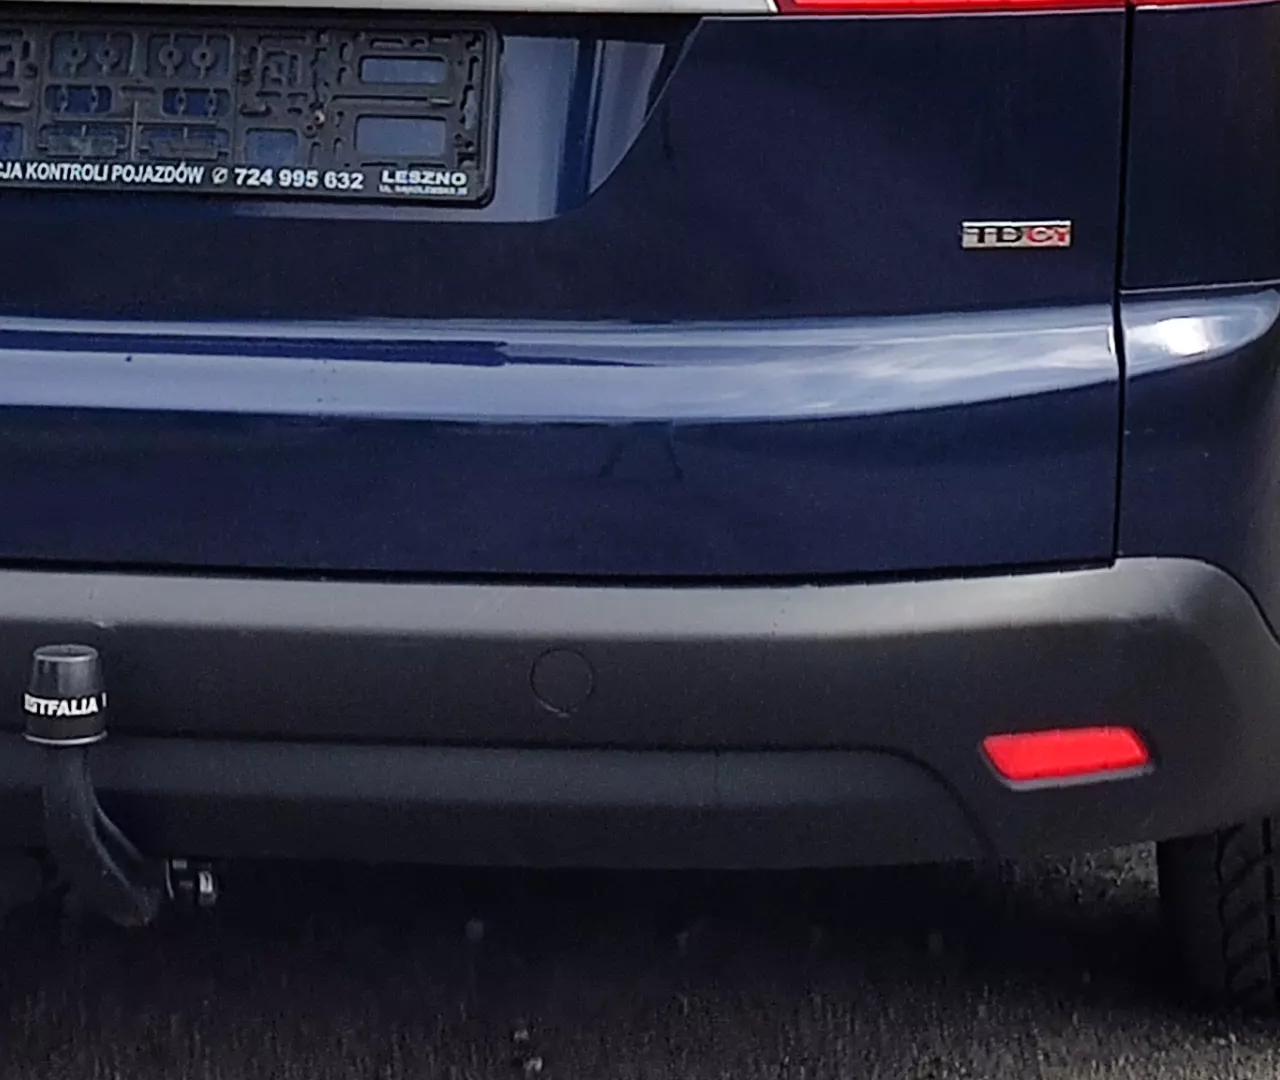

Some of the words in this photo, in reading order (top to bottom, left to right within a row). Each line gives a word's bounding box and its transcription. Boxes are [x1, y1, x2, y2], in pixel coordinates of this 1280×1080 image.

[25, 162, 109, 183] KONTROLI
[111, 161, 205, 185] POJAZDÓW
[234, 167, 274, 187] 724
[278, 168, 319, 188] 995
[323, 170, 364, 190] 632
[381, 169, 468, 187] LESZNO
